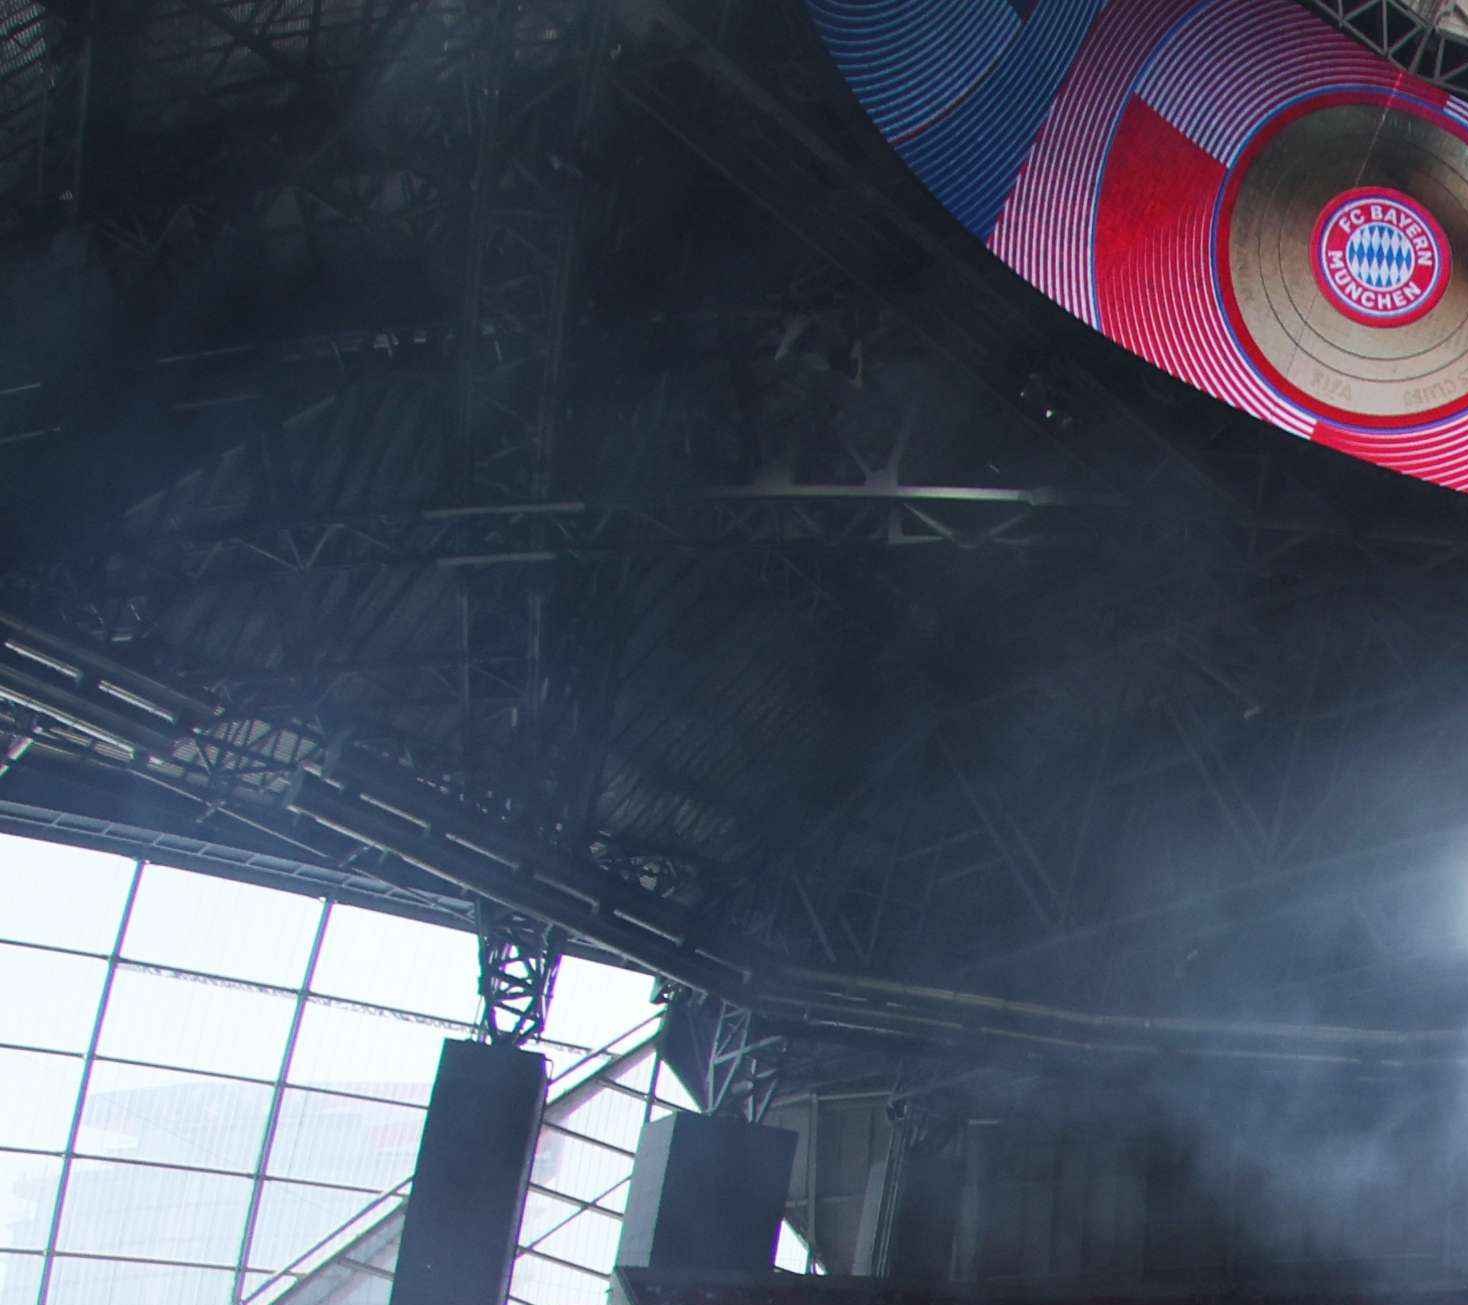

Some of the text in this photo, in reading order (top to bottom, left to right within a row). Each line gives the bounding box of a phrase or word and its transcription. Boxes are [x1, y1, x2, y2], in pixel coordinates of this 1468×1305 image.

[1339, 205, 1433, 266] FC BAYERN
[1328, 250, 1422, 310] MÜNCHEN
